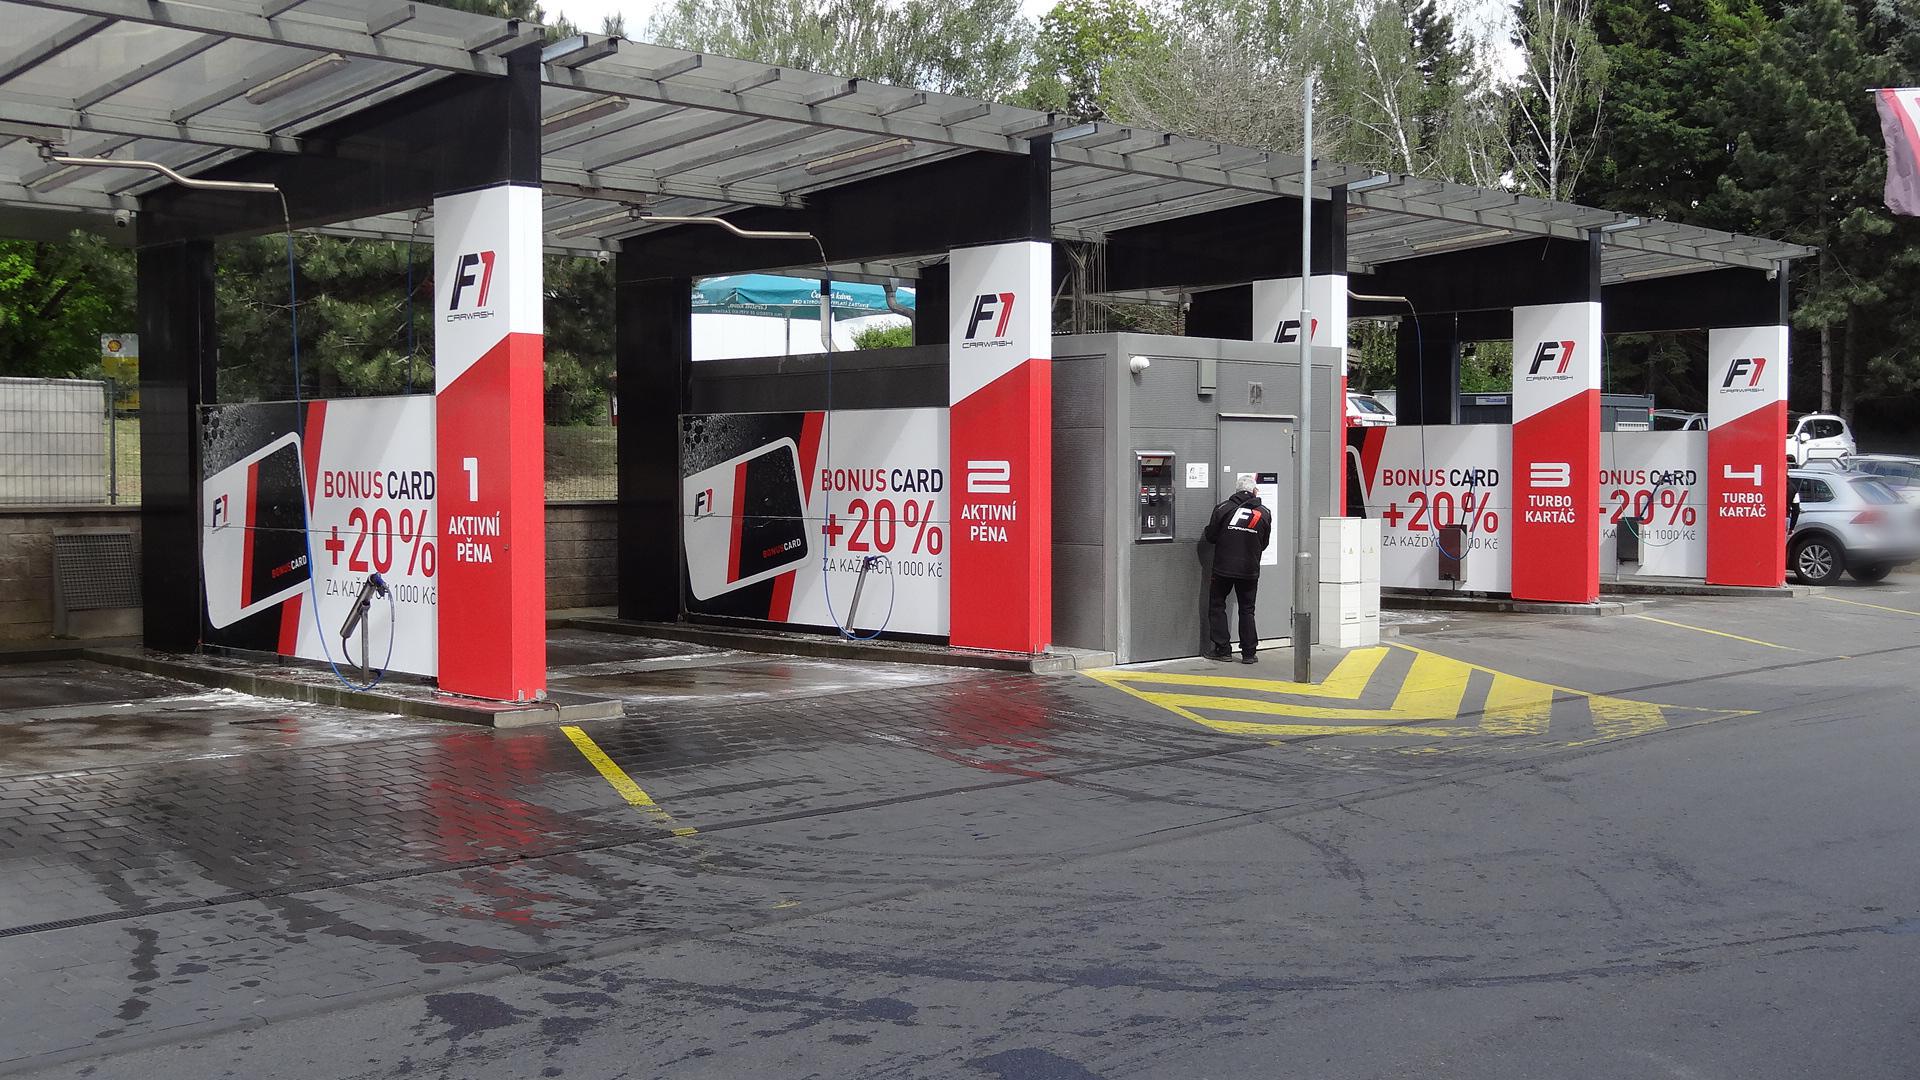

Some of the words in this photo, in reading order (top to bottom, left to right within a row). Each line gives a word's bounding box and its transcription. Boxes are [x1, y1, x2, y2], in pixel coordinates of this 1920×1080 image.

[449, 250, 496, 310] F1
[447, 310, 495, 323] CARWASH
[965, 292, 1016, 340] F1
[962, 340, 1013, 349] CARWASH
[1528, 340, 1576, 375] F1
[1722, 358, 1767, 388] F1
[324, 471, 383, 498] BONUS
[387, 471, 435, 500] CARD
[463, 457, 478, 502] 1
[821, 469, 887, 492] BONUS
[891, 469, 943, 493] CARD
[967, 460, 1011, 493] 2
[1383, 469, 1445, 487] BONUS
[1449, 469, 1499, 487] CARD
[1530, 462, 1571, 488] 3
[1600, 470, 1646, 486] ONUS
[1649, 470, 1697, 486] CARD
[1724, 464, 1762, 487] 4
[694, 488, 713, 517] F1
[1528, 495, 1572, 507] TURBO
[1722, 492, 1763, 503] TURBO
[212, 494, 228, 528] F1
[961, 501, 1017, 521] AKTIVNÍ
[1229, 507, 1262, 529] F1
[1383, 491, 1499, 533] +20%
[1525, 508, 1575, 523] KARTÁČ
[1719, 504, 1767, 517] KARTÁČ
[448, 511, 500, 536] AKTIVNÍ
[822, 498, 943, 556] +20%
[970, 522, 1008, 543] PĚNA
[1656, 529, 1679, 541] 1000
[1683, 530, 1696, 541] Kč
[325, 507, 436, 578] +20%
[457, 538, 493, 563] PĚNA
[1383, 535, 1397, 547] ZA
[1484, 538, 1499, 550] Kč
[823, 557, 837, 572] ZA
[897, 560, 924, 577] 1000
[928, 561, 943, 578] Kč
[326, 579, 342, 597] ZA
[394, 584, 419, 603] 1000
[422, 586, 436, 605] Kč
